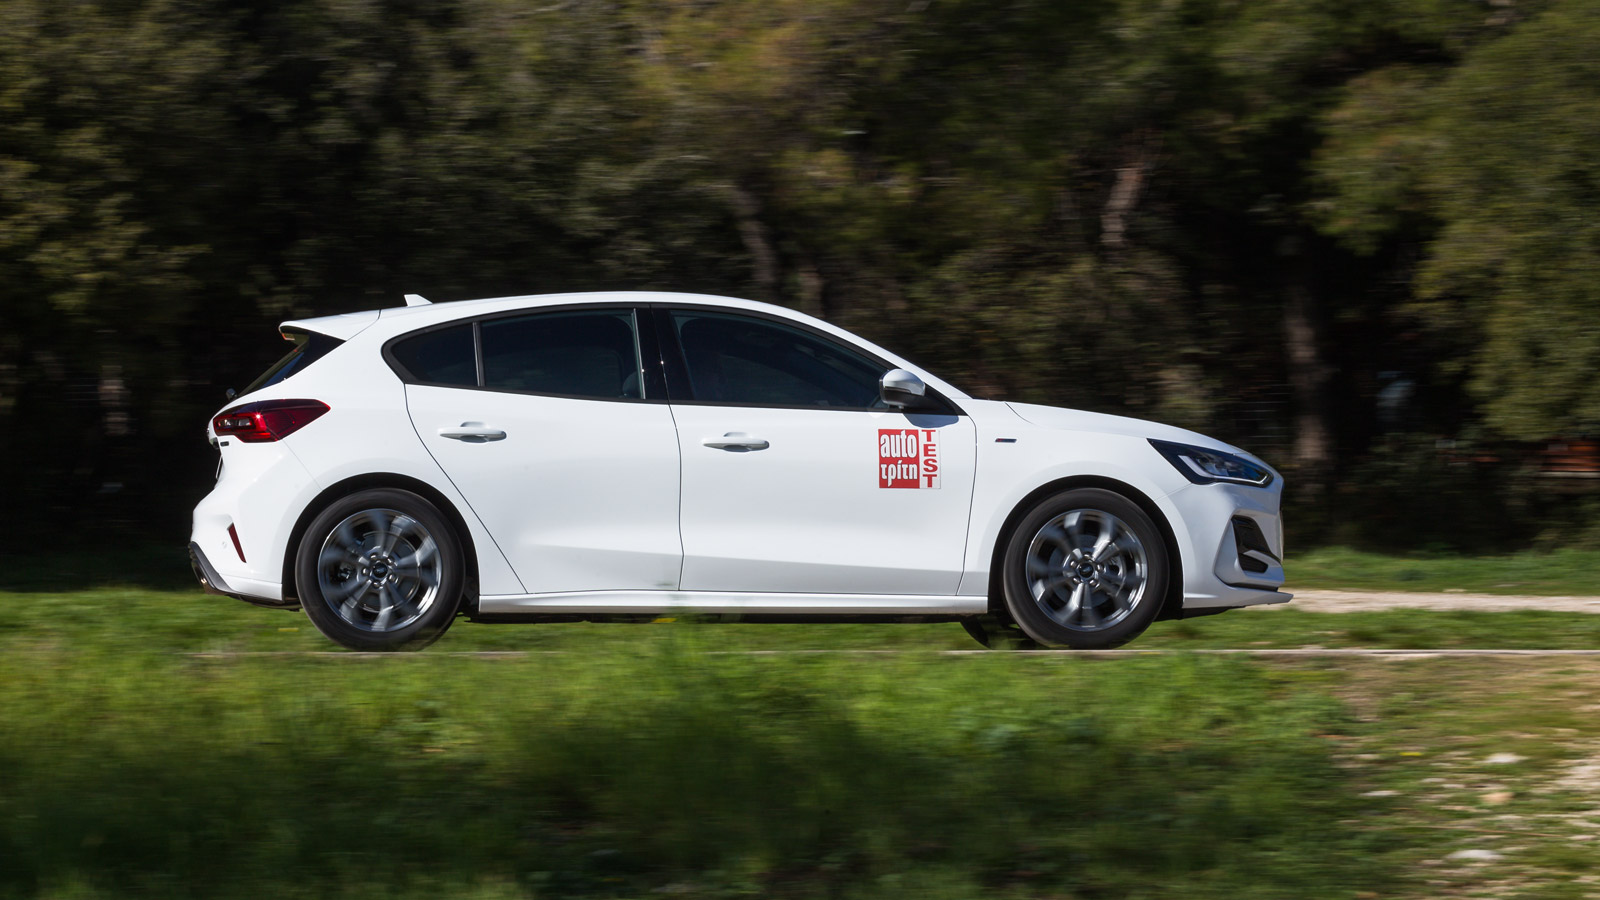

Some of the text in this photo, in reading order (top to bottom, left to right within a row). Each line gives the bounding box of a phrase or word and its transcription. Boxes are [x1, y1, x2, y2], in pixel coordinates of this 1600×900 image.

[880, 429, 917, 458] auto
[921, 429, 938, 488] TEST
[880, 460, 918, 487] τρίτη
